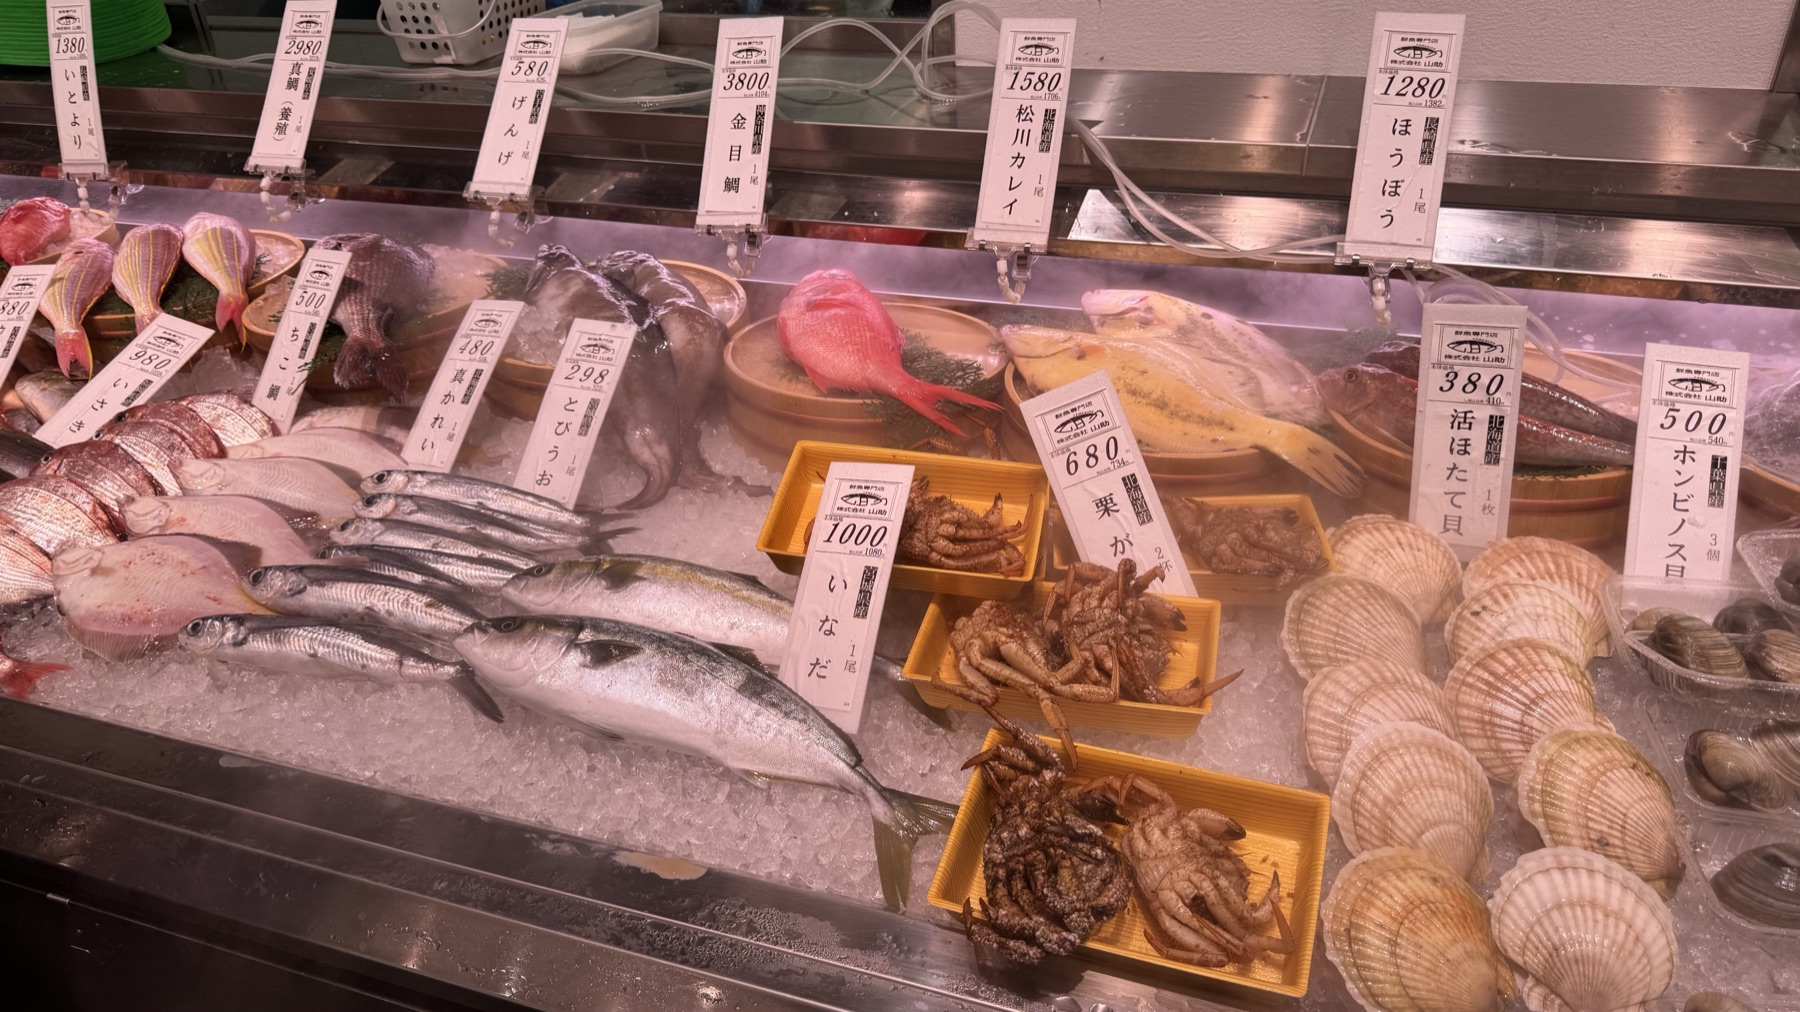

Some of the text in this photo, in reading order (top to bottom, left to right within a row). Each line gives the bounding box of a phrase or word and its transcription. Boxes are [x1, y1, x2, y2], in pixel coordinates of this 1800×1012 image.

[56, 37, 85, 54] 1380
[284, 40, 322, 55] 2980
[511, 60, 549, 77] 580
[723, 72, 770, 91] 3800
[1007, 71, 1062, 92] 1580
[1380, 75, 1446, 99] 1280
[65, 69, 81, 149] いとより
[498, 95, 528, 166] げんげ
[751, 104, 766, 155] 神奈川県産
[1038, 109, 1057, 154] 北海道産
[1419, 117, 1440, 165] 長崎県産
[522, 141, 530, 160] 1尾
[723, 112, 747, 194] 金目鯛
[1002, 104, 1035, 215] 松川カレイ
[750, 164, 759, 186] 1尾
[1033, 174, 1044, 198] 1尾
[1380, 118, 1412, 229] ほうぼう
[1414, 188, 1426, 213] 1尾
[296, 291, 326, 309] 500
[129, 350, 171, 369] 980
[459, 339, 494, 355] 480
[564, 365, 609, 384] 298
[1439, 371, 1504, 396] 380
[69, 378, 128, 433] いさき
[421, 368, 467, 451] 真かれい
[1486, 397, 1501, 405] 410
[1660, 408, 1727, 435] 500
[536, 397, 578, 486] とびうお
[1484, 414, 1504, 466] 北海道産
[1708, 436, 1724, 445] 540
[566, 455, 576, 476] 1尾
[1066, 436, 1118, 475] 680
[1111, 458, 1125, 469] 734
[1439, 408, 1475, 536] 活ほたて貝
[1707, 455, 1727, 509] 千葉県産
[1121, 473, 1154, 526] 北海道産
[1482, 489, 1495, 516] 1枚
[823, 522, 887, 547] 1000
[1706, 533, 1720, 562] 3個
[865, 548, 882, 556] 1080
[808, 575, 848, 679] いなだ
[844, 644, 856, 673] 1尾
